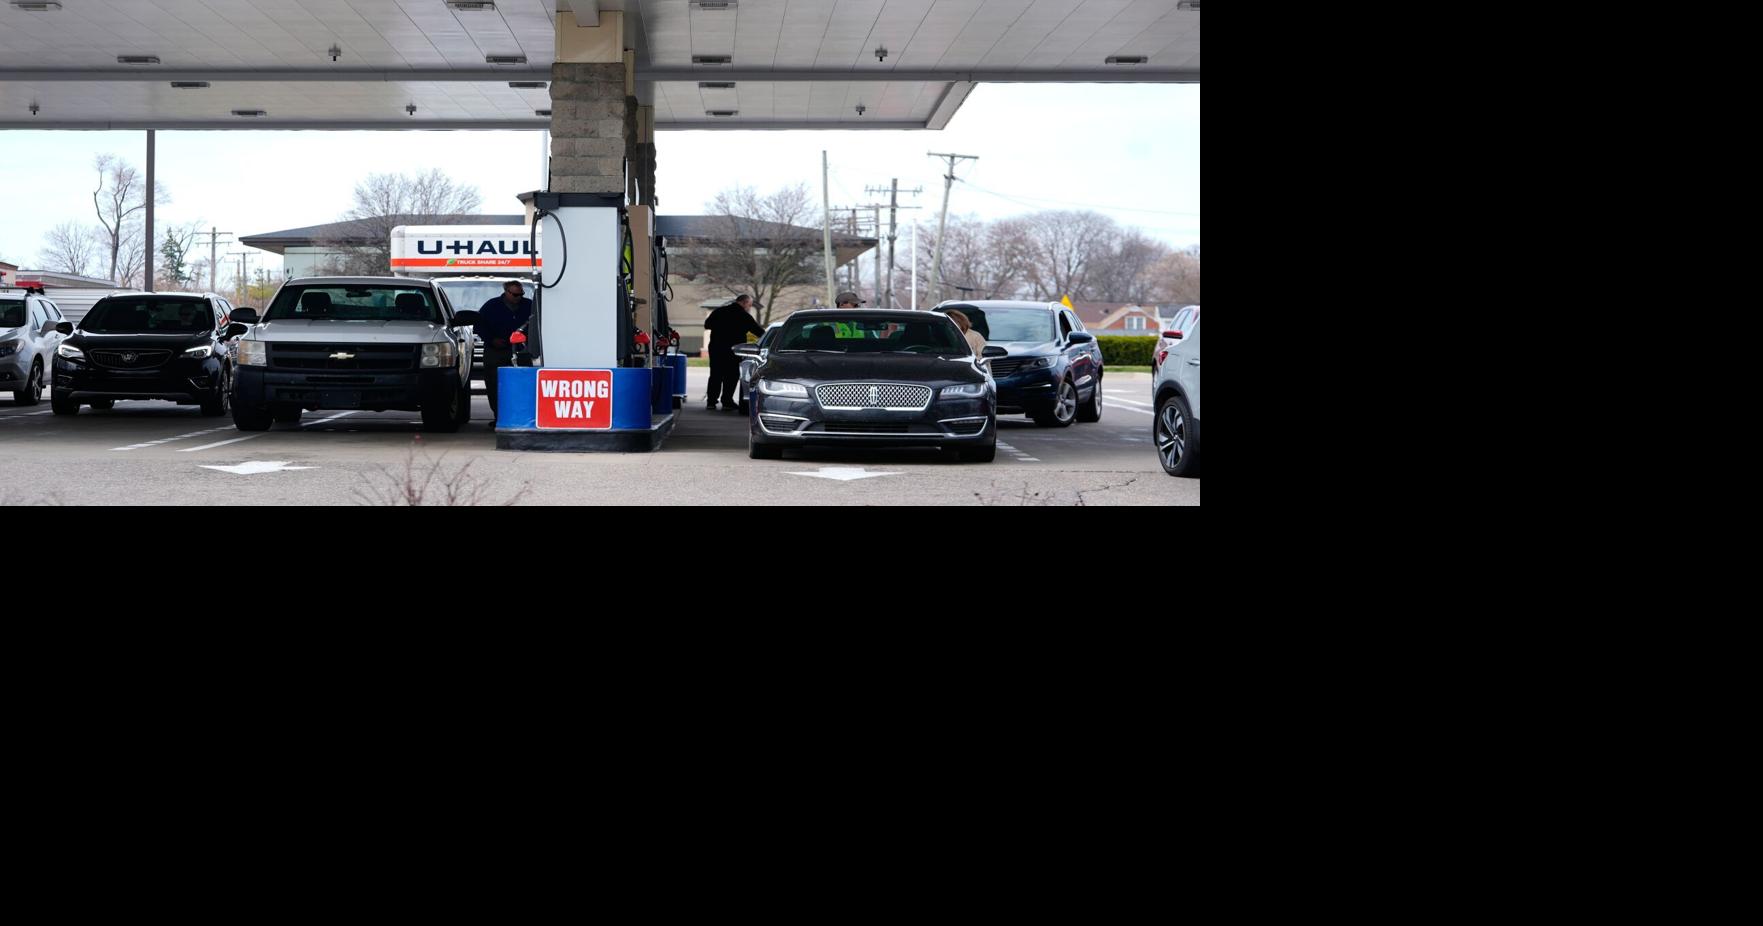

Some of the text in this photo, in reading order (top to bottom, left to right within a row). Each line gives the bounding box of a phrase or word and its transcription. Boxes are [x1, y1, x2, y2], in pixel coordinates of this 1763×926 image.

[417, 240, 539, 255] U-HAUL
[541, 380, 609, 398] WRONG
[554, 400, 594, 418] WAY
